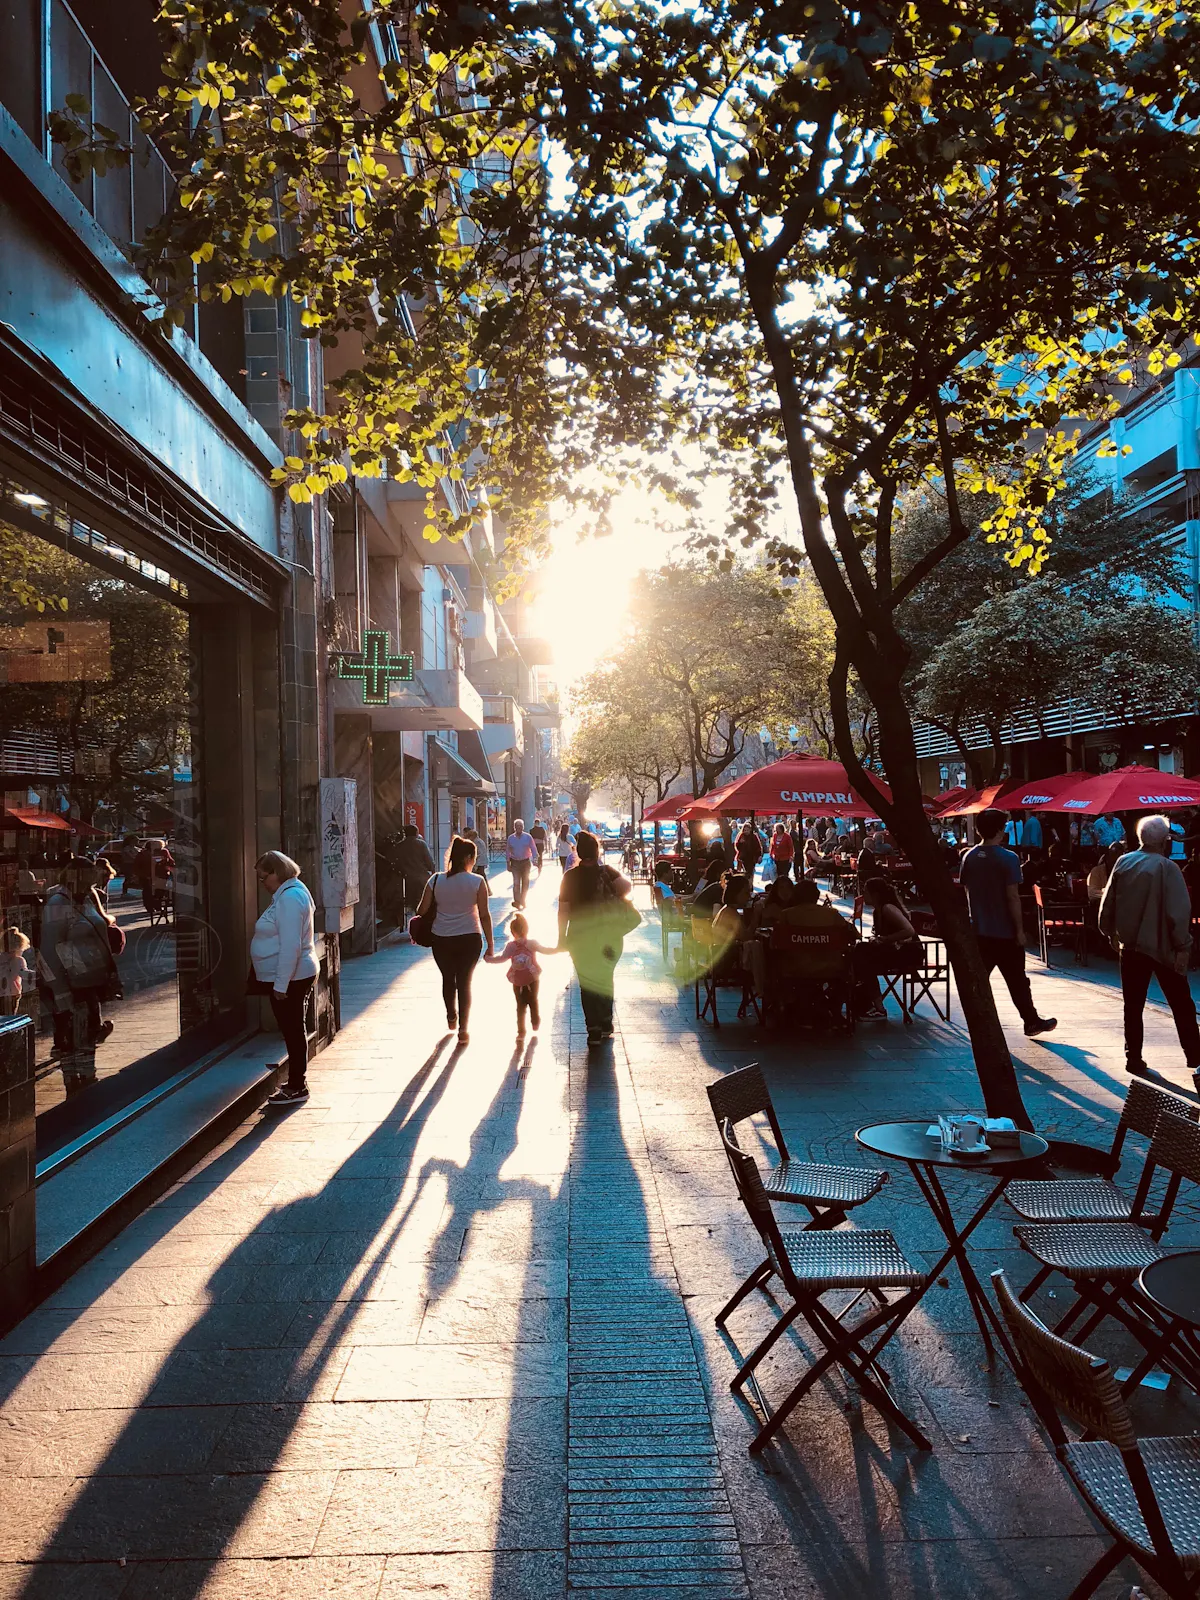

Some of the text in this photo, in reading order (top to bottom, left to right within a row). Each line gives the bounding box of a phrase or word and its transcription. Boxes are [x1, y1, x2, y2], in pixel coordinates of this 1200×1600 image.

[779, 790, 854, 804] CAMPARI
[1021, 795, 1054, 805] CAMPA
[409, 808, 417, 826] aro
[791, 934, 830, 944] CAMPARI
